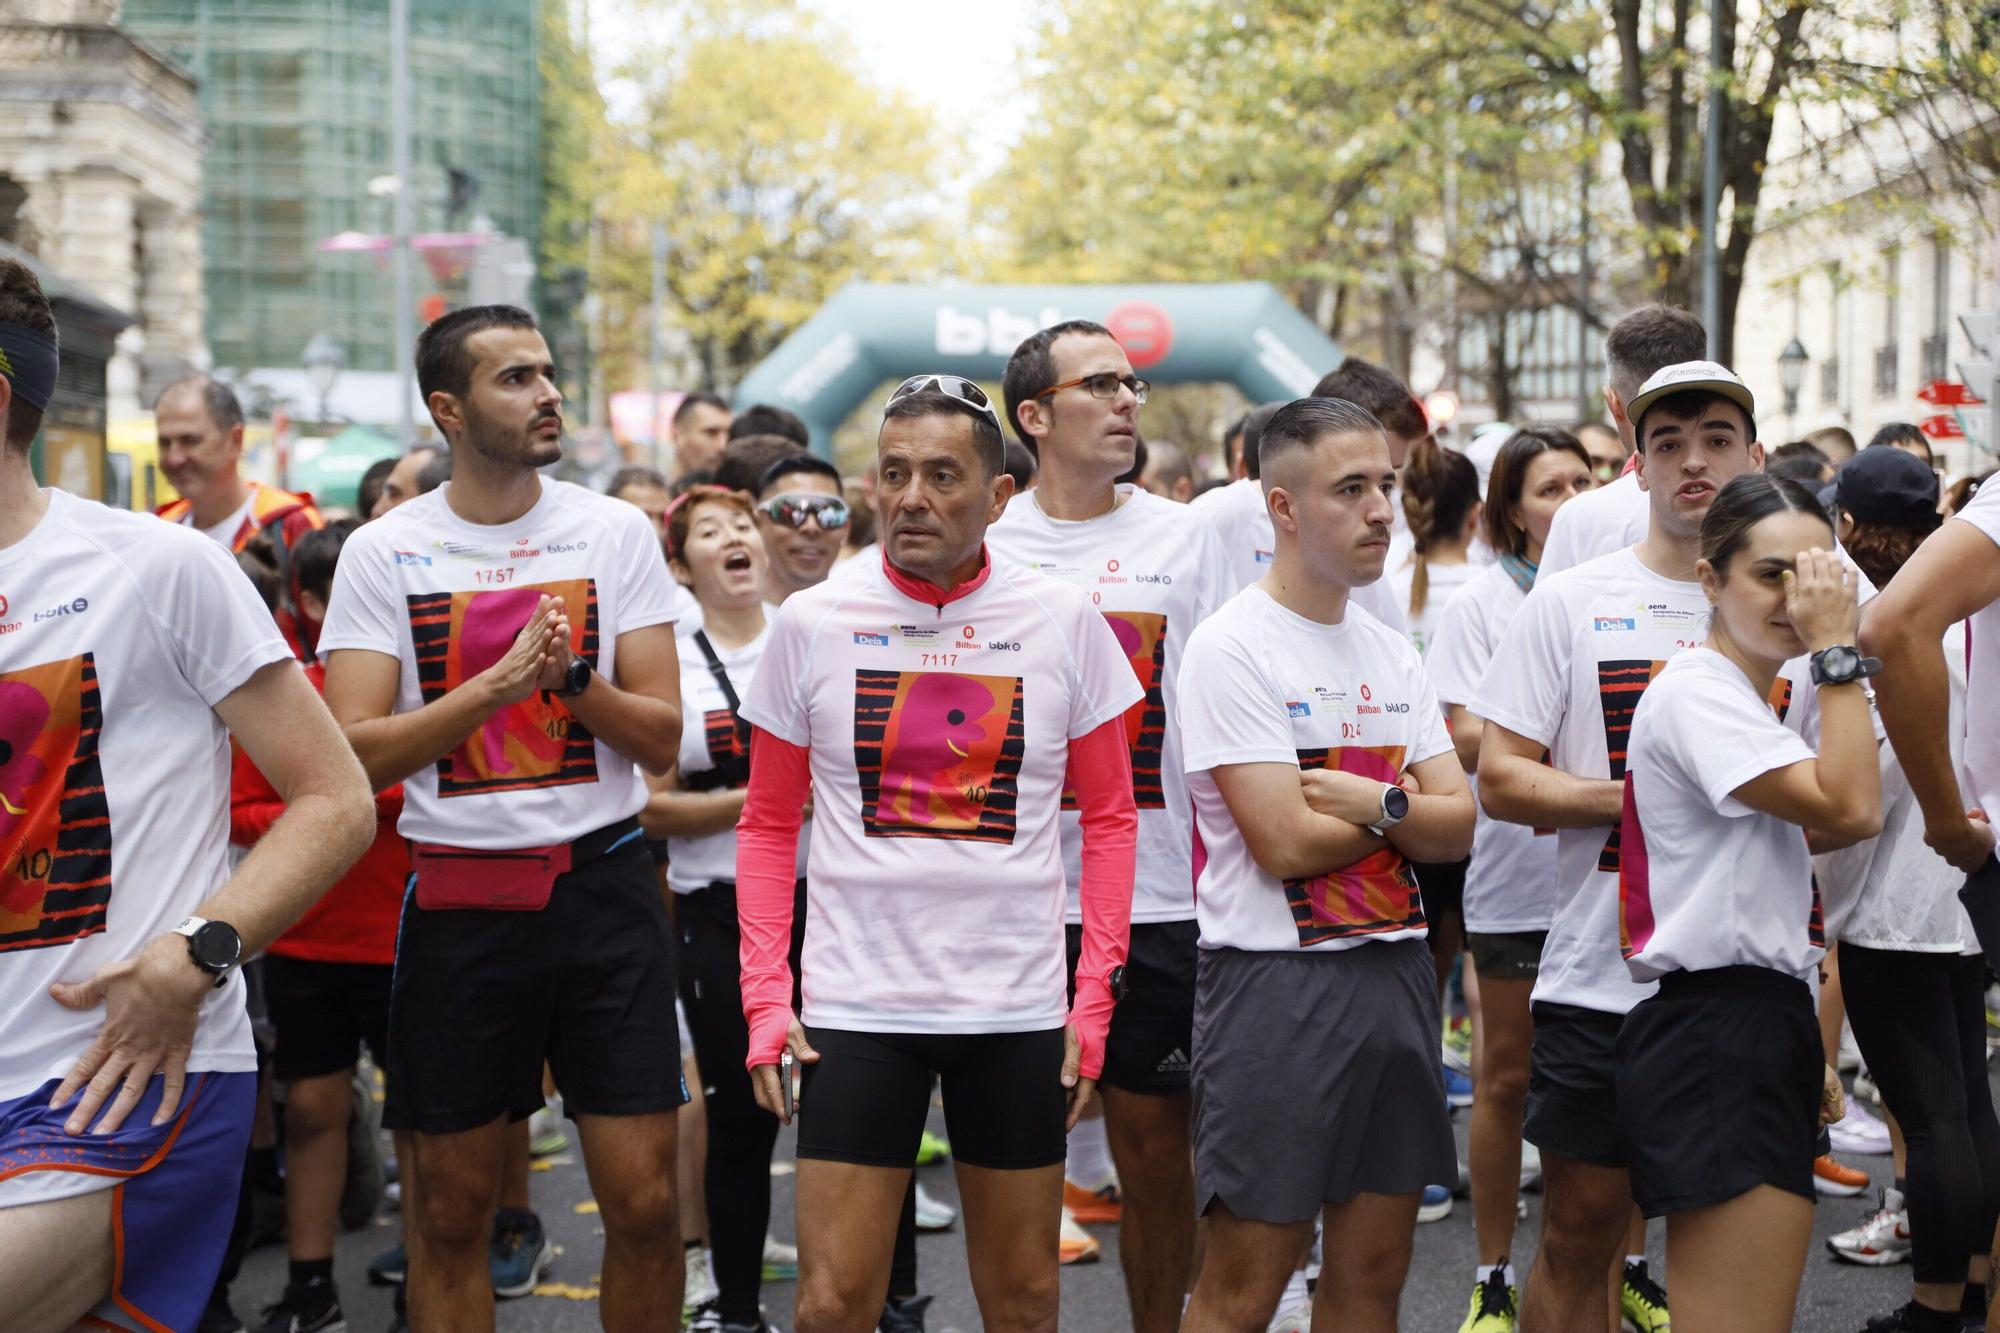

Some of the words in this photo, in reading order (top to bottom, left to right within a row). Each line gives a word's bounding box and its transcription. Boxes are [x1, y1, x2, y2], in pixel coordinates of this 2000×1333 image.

[509, 549, 540, 559] Bilbao
[475, 567, 514, 584] 1757
[1099, 575, 1128, 584] Bilbao
[1135, 574, 1161, 584] bbk
[1600, 620, 1628, 631] Deia
[859, 636, 882, 646] Deia
[955, 641, 981, 650] Bilbao
[989, 642, 1011, 651] bbk
[922, 654, 958, 666] 7117
[1290, 705, 1306, 717] eia
[1357, 705, 1381, 715] Bilbao
[967, 785, 987, 803] 10
[16, 848, 51, 880] 10
